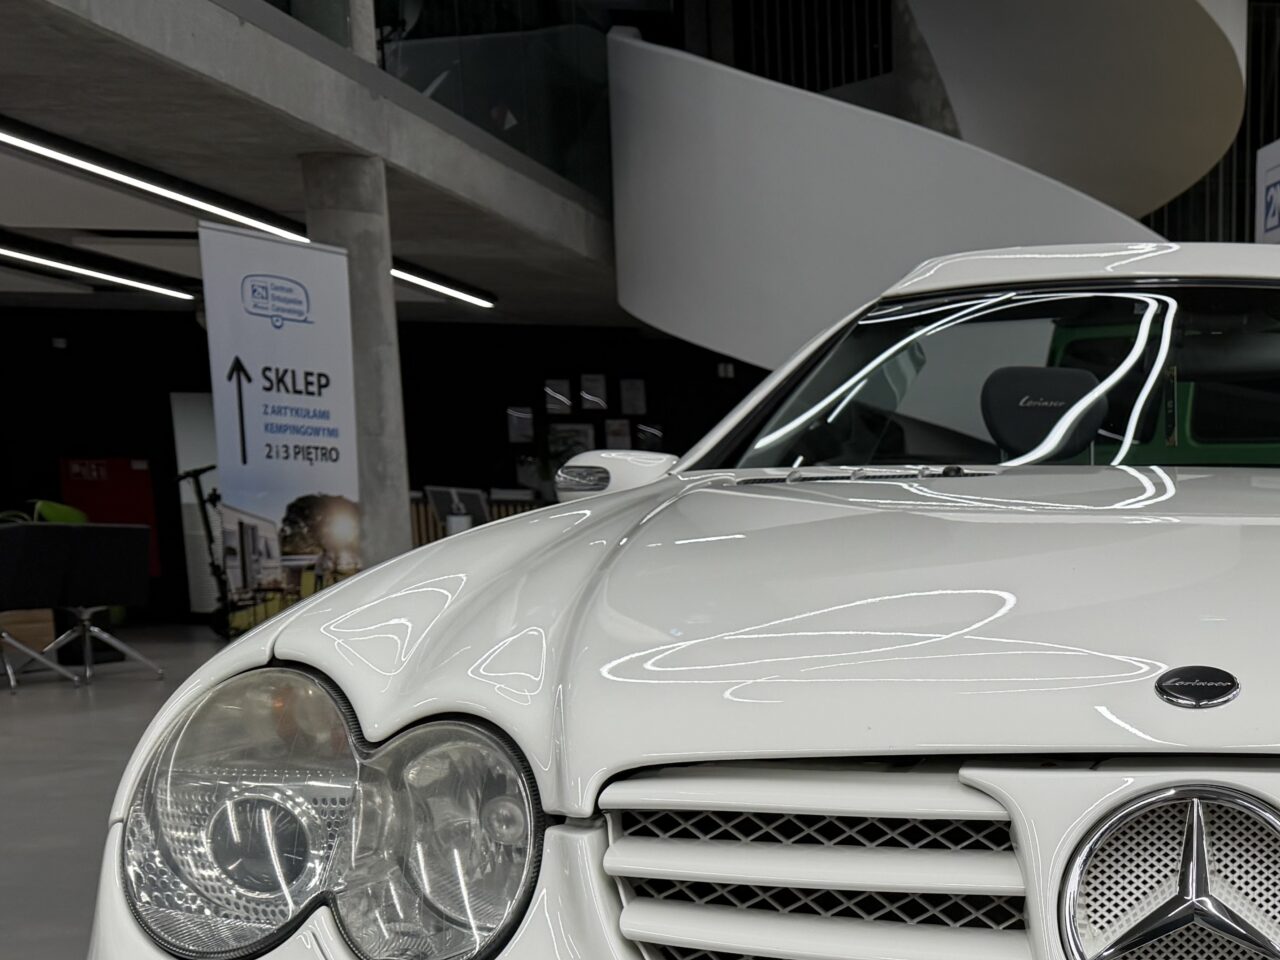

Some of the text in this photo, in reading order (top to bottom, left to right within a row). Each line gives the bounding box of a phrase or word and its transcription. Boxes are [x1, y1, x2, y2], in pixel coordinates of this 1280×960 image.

[261, 366, 330, 396] SKLEP
[262, 404, 270, 416] Z
[265, 443, 273, 459] 2
[282, 444, 290, 460] 3
[293, 445, 340, 466] PIĘTRO
